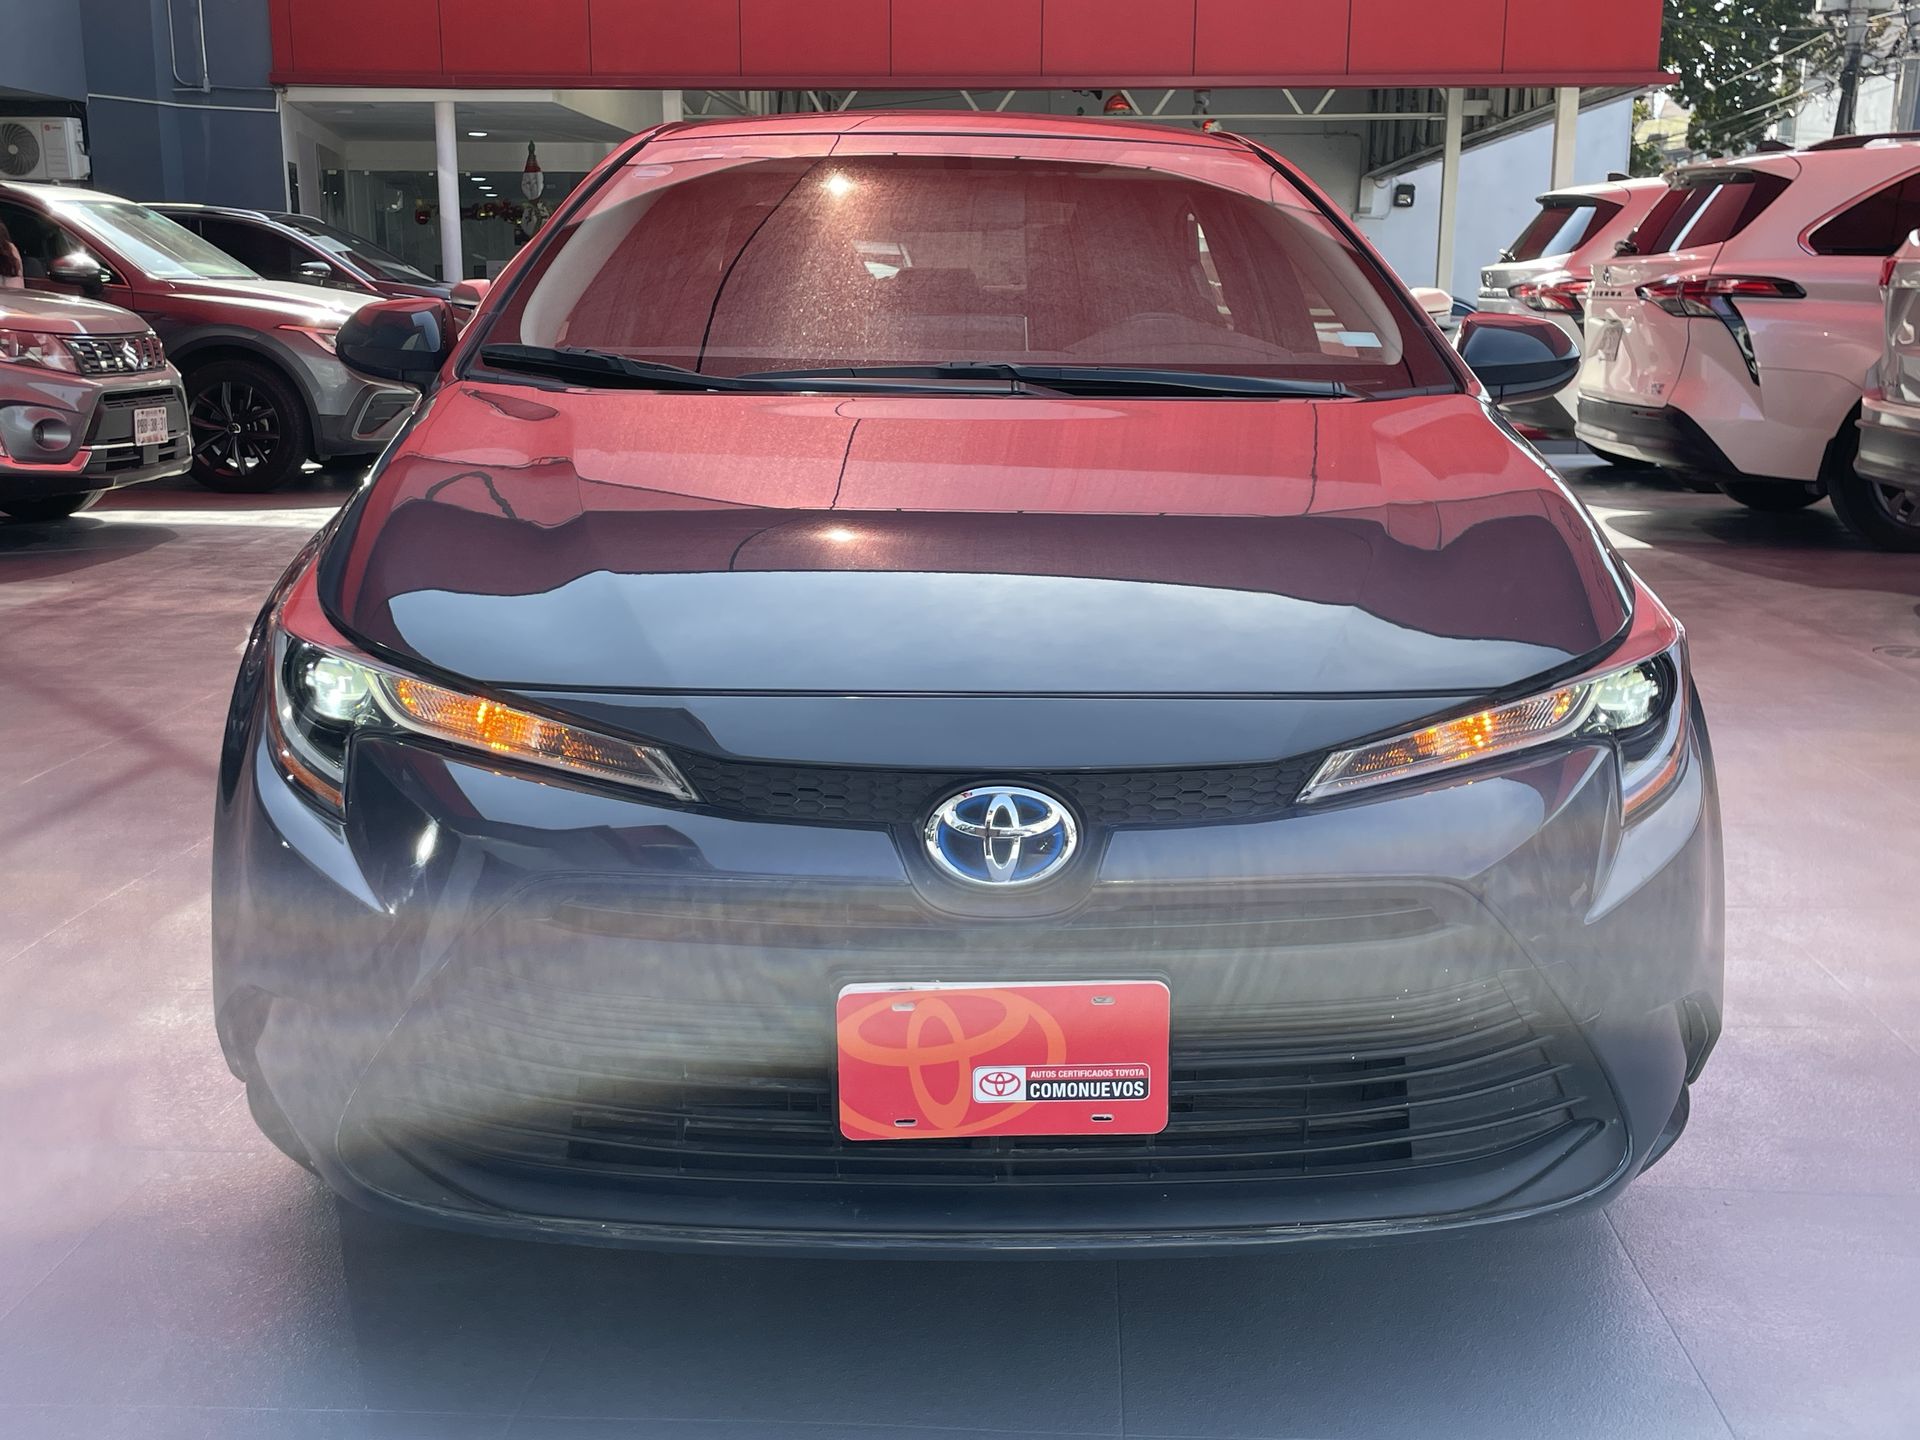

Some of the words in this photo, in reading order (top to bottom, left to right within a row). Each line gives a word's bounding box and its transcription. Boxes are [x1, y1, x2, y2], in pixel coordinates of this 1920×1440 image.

[1030, 1070, 1057, 1079] AUTOS
[1058, 1069, 1113, 1078] CERTIFICADOS
[1114, 1068, 1145, 1077] TOYOTA
[1030, 1080, 1145, 1098] COMONUEVOS
